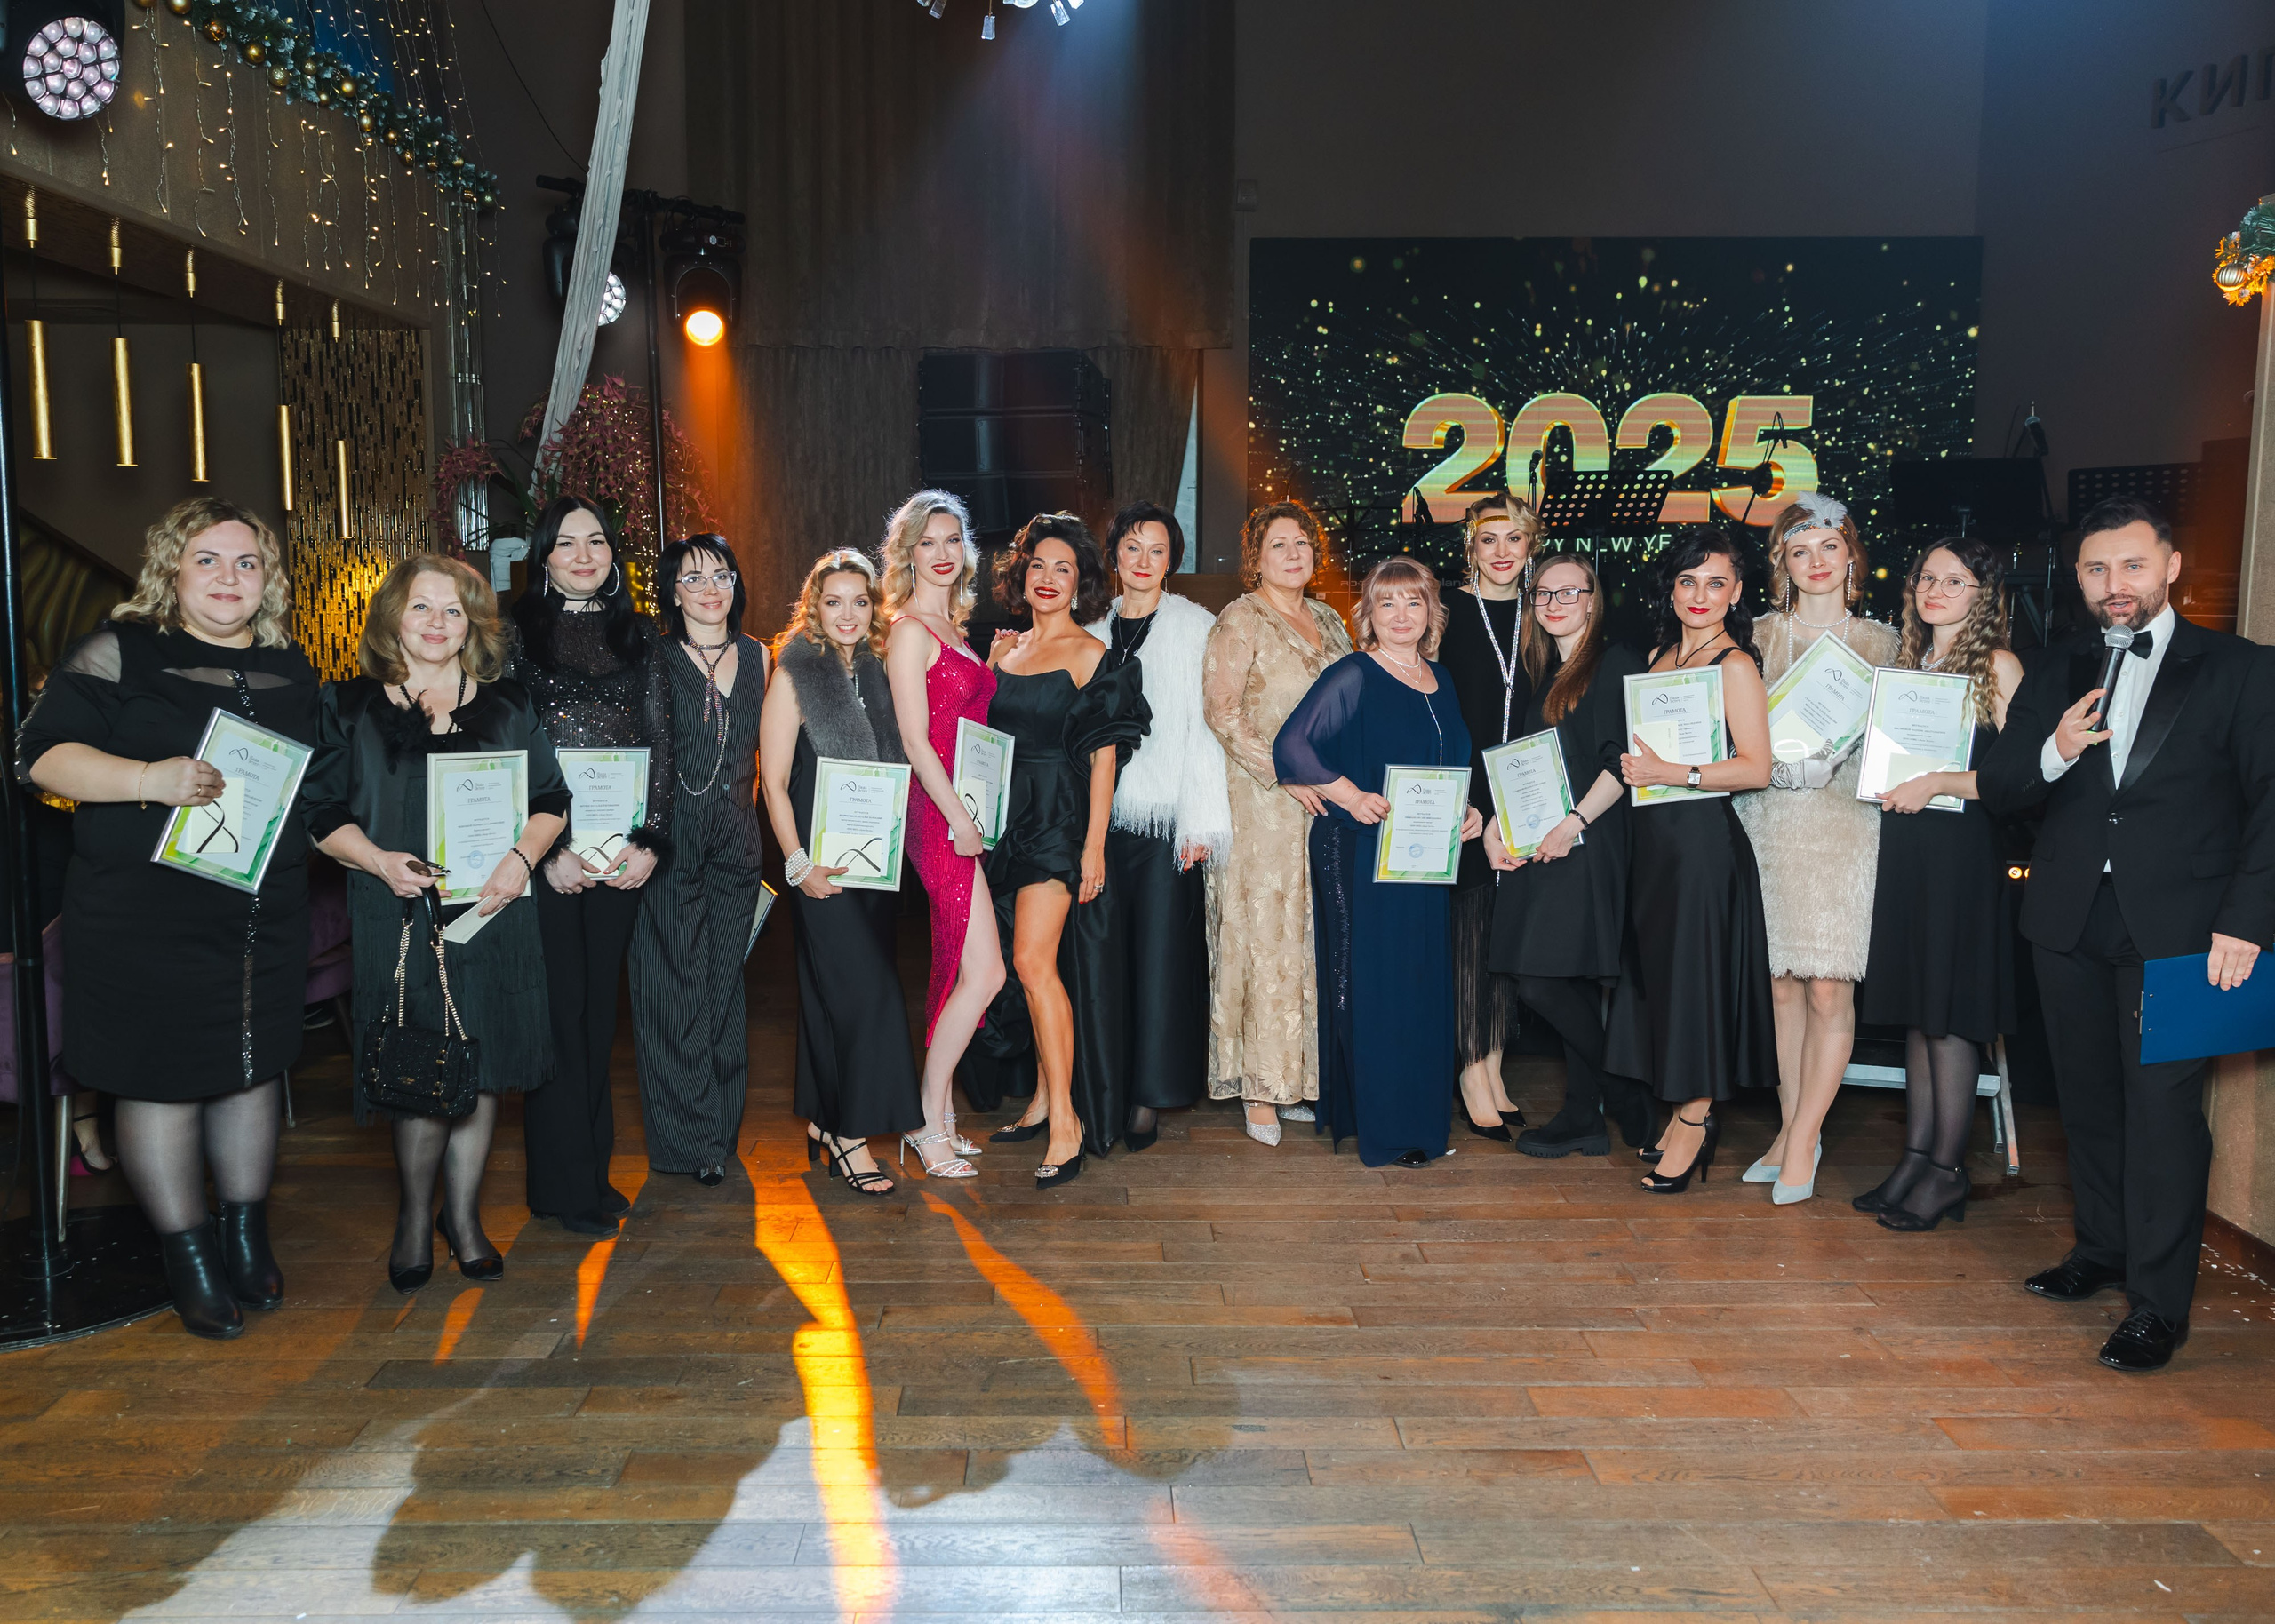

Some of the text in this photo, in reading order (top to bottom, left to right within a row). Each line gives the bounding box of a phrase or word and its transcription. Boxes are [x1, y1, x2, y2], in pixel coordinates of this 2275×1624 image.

[1402, 392, 1819, 527] 2025
[1576, 537, 1633, 553] NW
[1643, 533, 1672, 553] YE
[235, 767, 260, 781] ГРАМОТА
